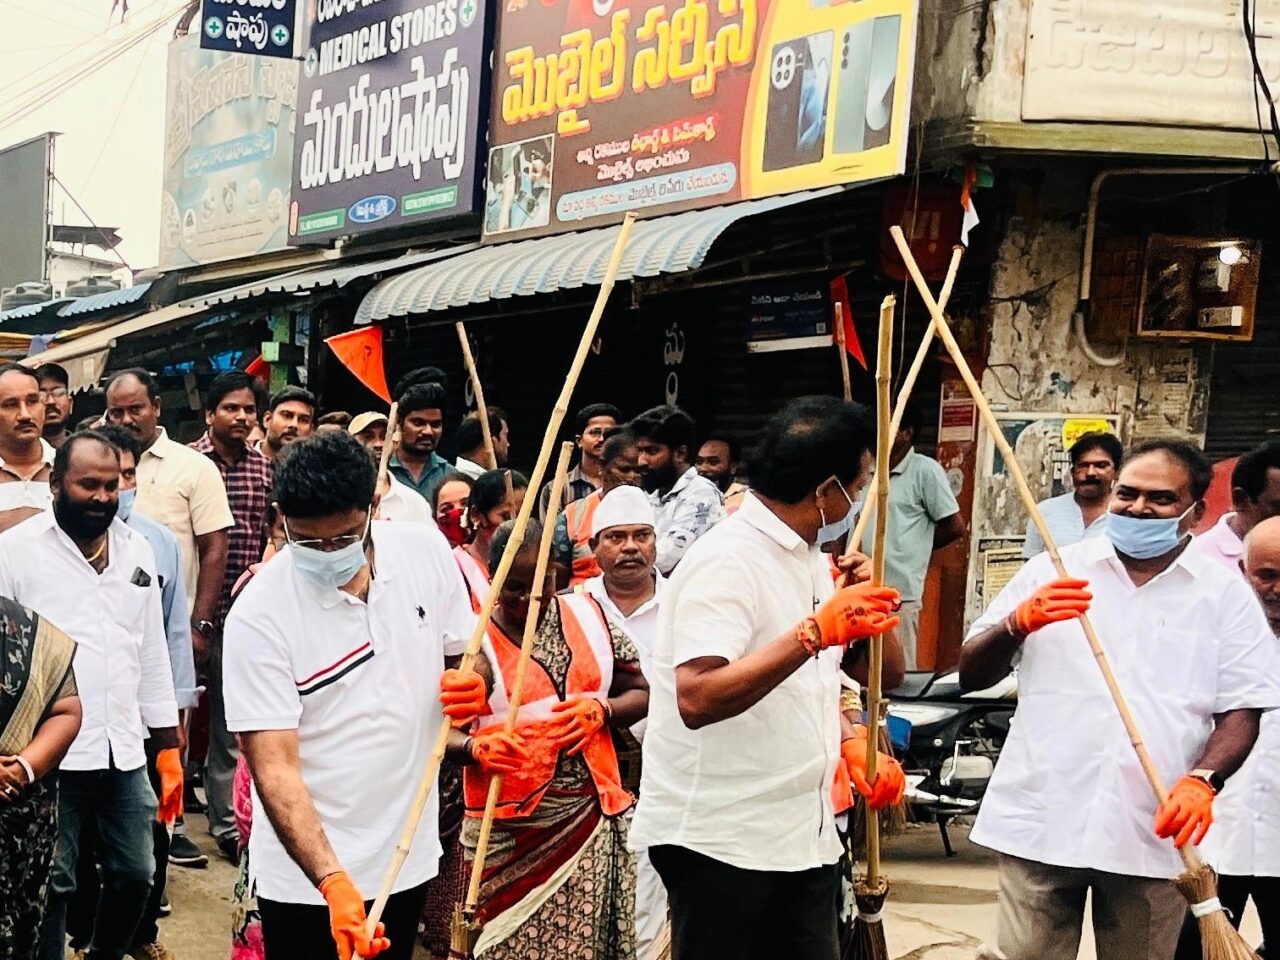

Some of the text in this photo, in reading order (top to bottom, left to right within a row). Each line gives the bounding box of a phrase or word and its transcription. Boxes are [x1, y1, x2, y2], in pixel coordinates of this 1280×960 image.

[225, 10, 269, 50] షాపు
[319, 20, 387, 76] MEDICAL
[390, 0, 457, 54] STORES
[502, 8, 631, 137] మొబైల్
